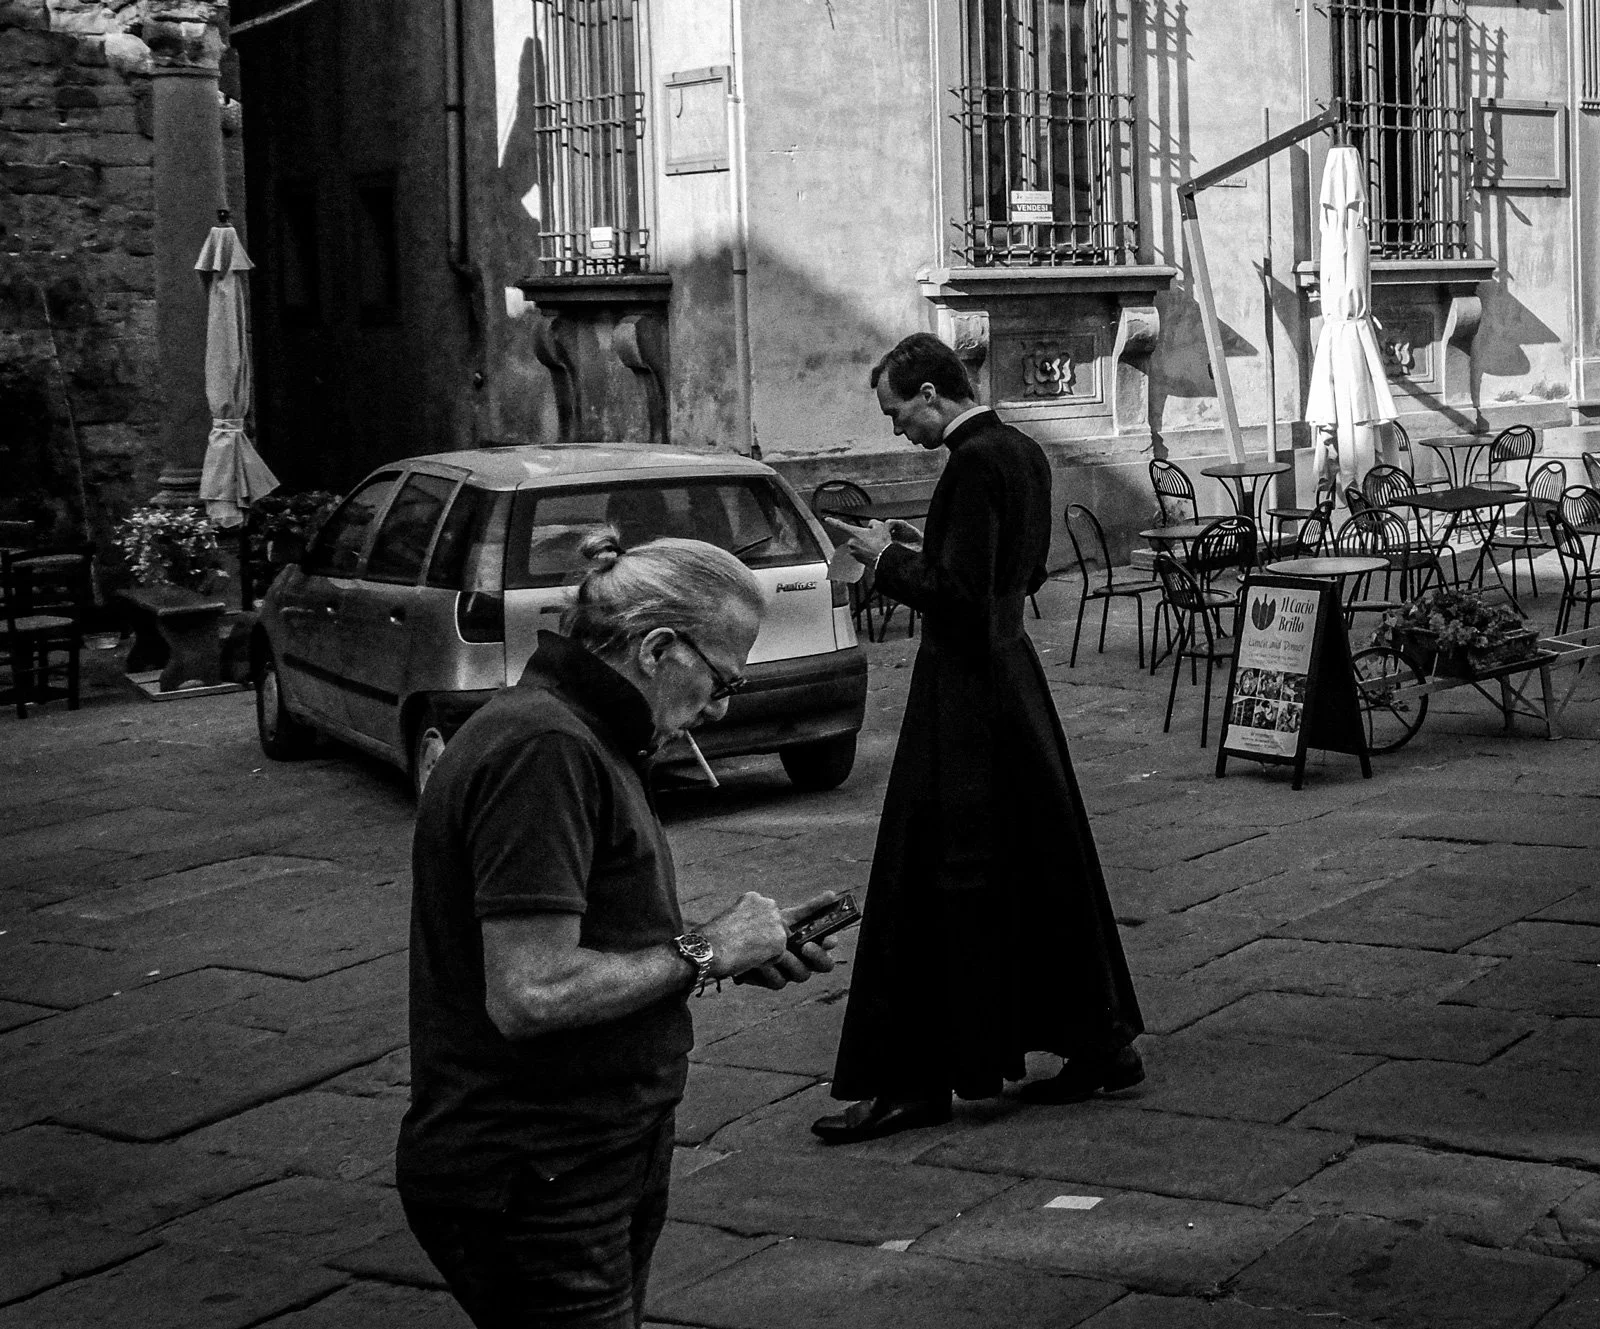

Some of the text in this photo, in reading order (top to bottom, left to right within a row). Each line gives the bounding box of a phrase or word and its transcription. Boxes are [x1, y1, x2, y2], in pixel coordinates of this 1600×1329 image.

[1016, 204, 1048, 212] VENDESI
[1281, 596, 1315, 615] Il Cacio
[1278, 616, 1304, 633] Brillo
